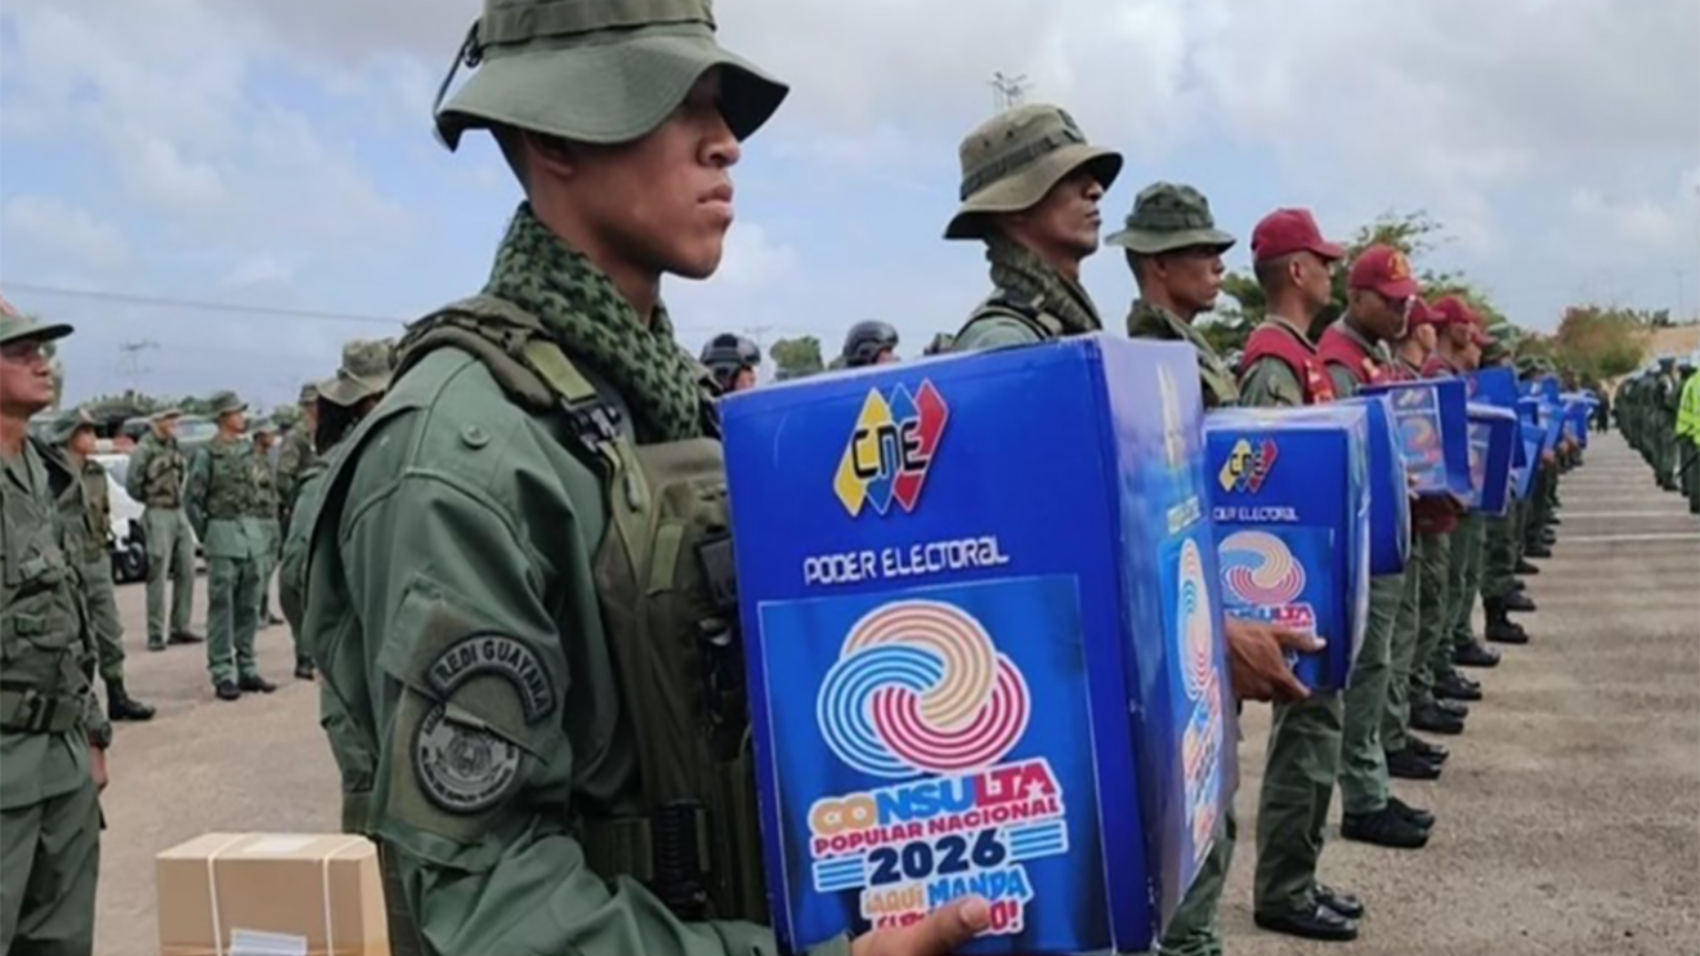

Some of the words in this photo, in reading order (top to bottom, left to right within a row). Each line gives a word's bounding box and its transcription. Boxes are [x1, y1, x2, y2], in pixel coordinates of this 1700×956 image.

[803, 547, 876, 585] PODER
[882, 535, 1010, 577] ELECTORAL
[435, 644, 478, 682] REDI
[482, 639, 547, 712] GUAYANA
[811, 761, 1057, 835] CONSULTA
[814, 822, 923, 855] POPULAR
[928, 797, 1060, 835] NACIONAL
[868, 829, 1007, 886] 2026
[928, 869, 1028, 906] MANDA
